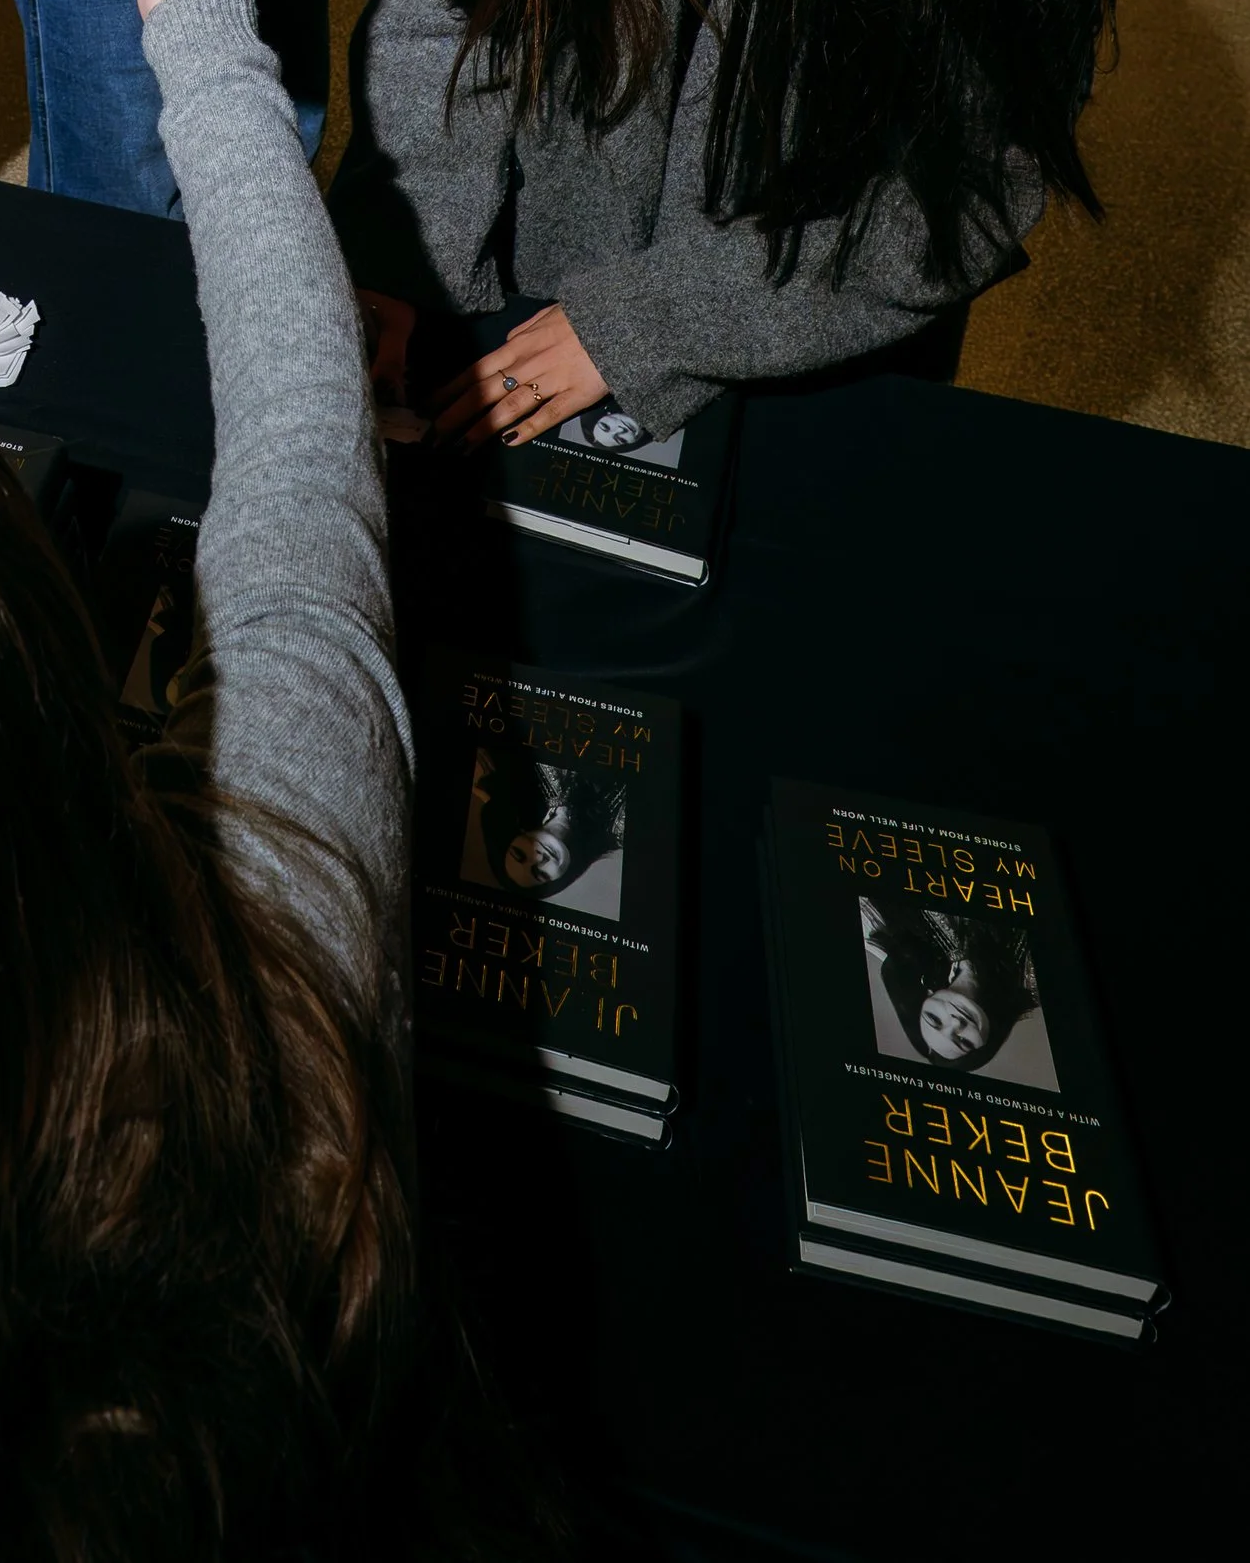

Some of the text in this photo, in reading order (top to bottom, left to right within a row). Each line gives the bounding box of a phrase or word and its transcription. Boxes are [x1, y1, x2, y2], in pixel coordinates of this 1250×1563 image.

[532, 439, 584, 458] EVANGELISTA
[585, 454, 609, 466] LINDA
[611, 460, 621, 469] BY
[623, 464, 668, 480] FOREWORD
[677, 476, 699, 489] WITH
[508, 680, 532, 692] WELL
[535, 687, 556, 698] LIFE
[559, 692, 565, 700] A
[568, 694, 597, 708] FROM
[461, 684, 651, 743] MY SLEEVE
[600, 702, 643, 719] STORIES
[466, 711, 642, 772] HEART ON
[832, 808, 1022, 852] STORIES FROM A LIFE WELL WORN
[825, 822, 1037, 880] MY SLEEVE
[838, 854, 1035, 916] HEART ON
[532, 914, 545, 924] BY
[549, 918, 608, 941] FOREWORD
[611, 935, 618, 944] A
[622, 938, 649, 953] WITH
[449, 911, 619, 989] BEKER
[844, 1062, 1100, 1127] WITH A FOREWORD BY LINDA EVANGELISTA
[881, 1093, 1077, 1174] BEKER
[863, 1139, 1111, 1231] JEANNE
